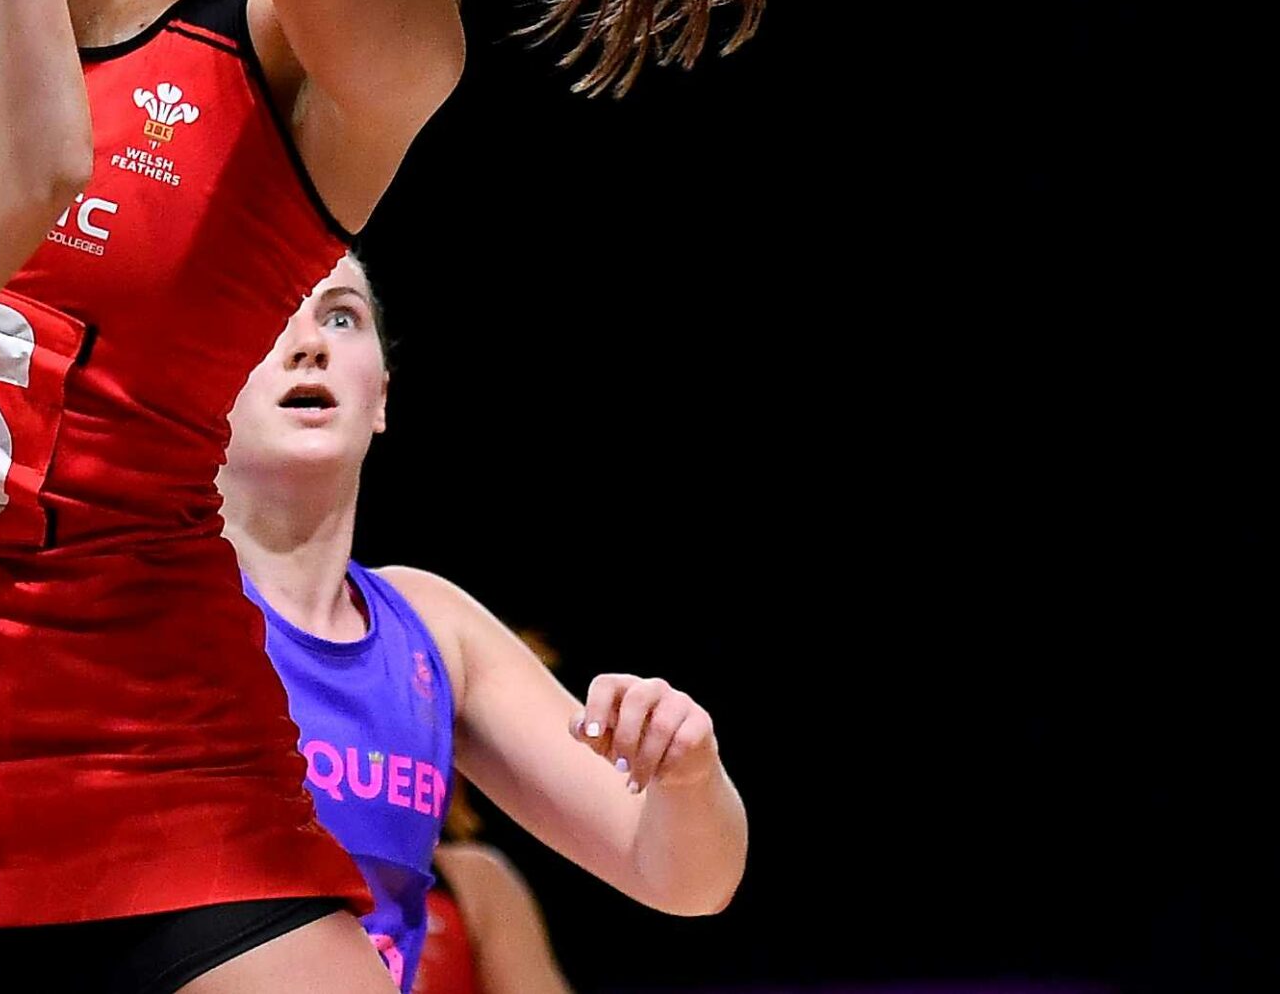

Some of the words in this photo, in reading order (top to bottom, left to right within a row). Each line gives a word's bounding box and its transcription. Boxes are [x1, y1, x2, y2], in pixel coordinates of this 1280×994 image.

[110, 154, 182, 187] FEATHERS
[125, 146, 174, 172] WELSH
[46, 230, 105, 256] COLLEGES
